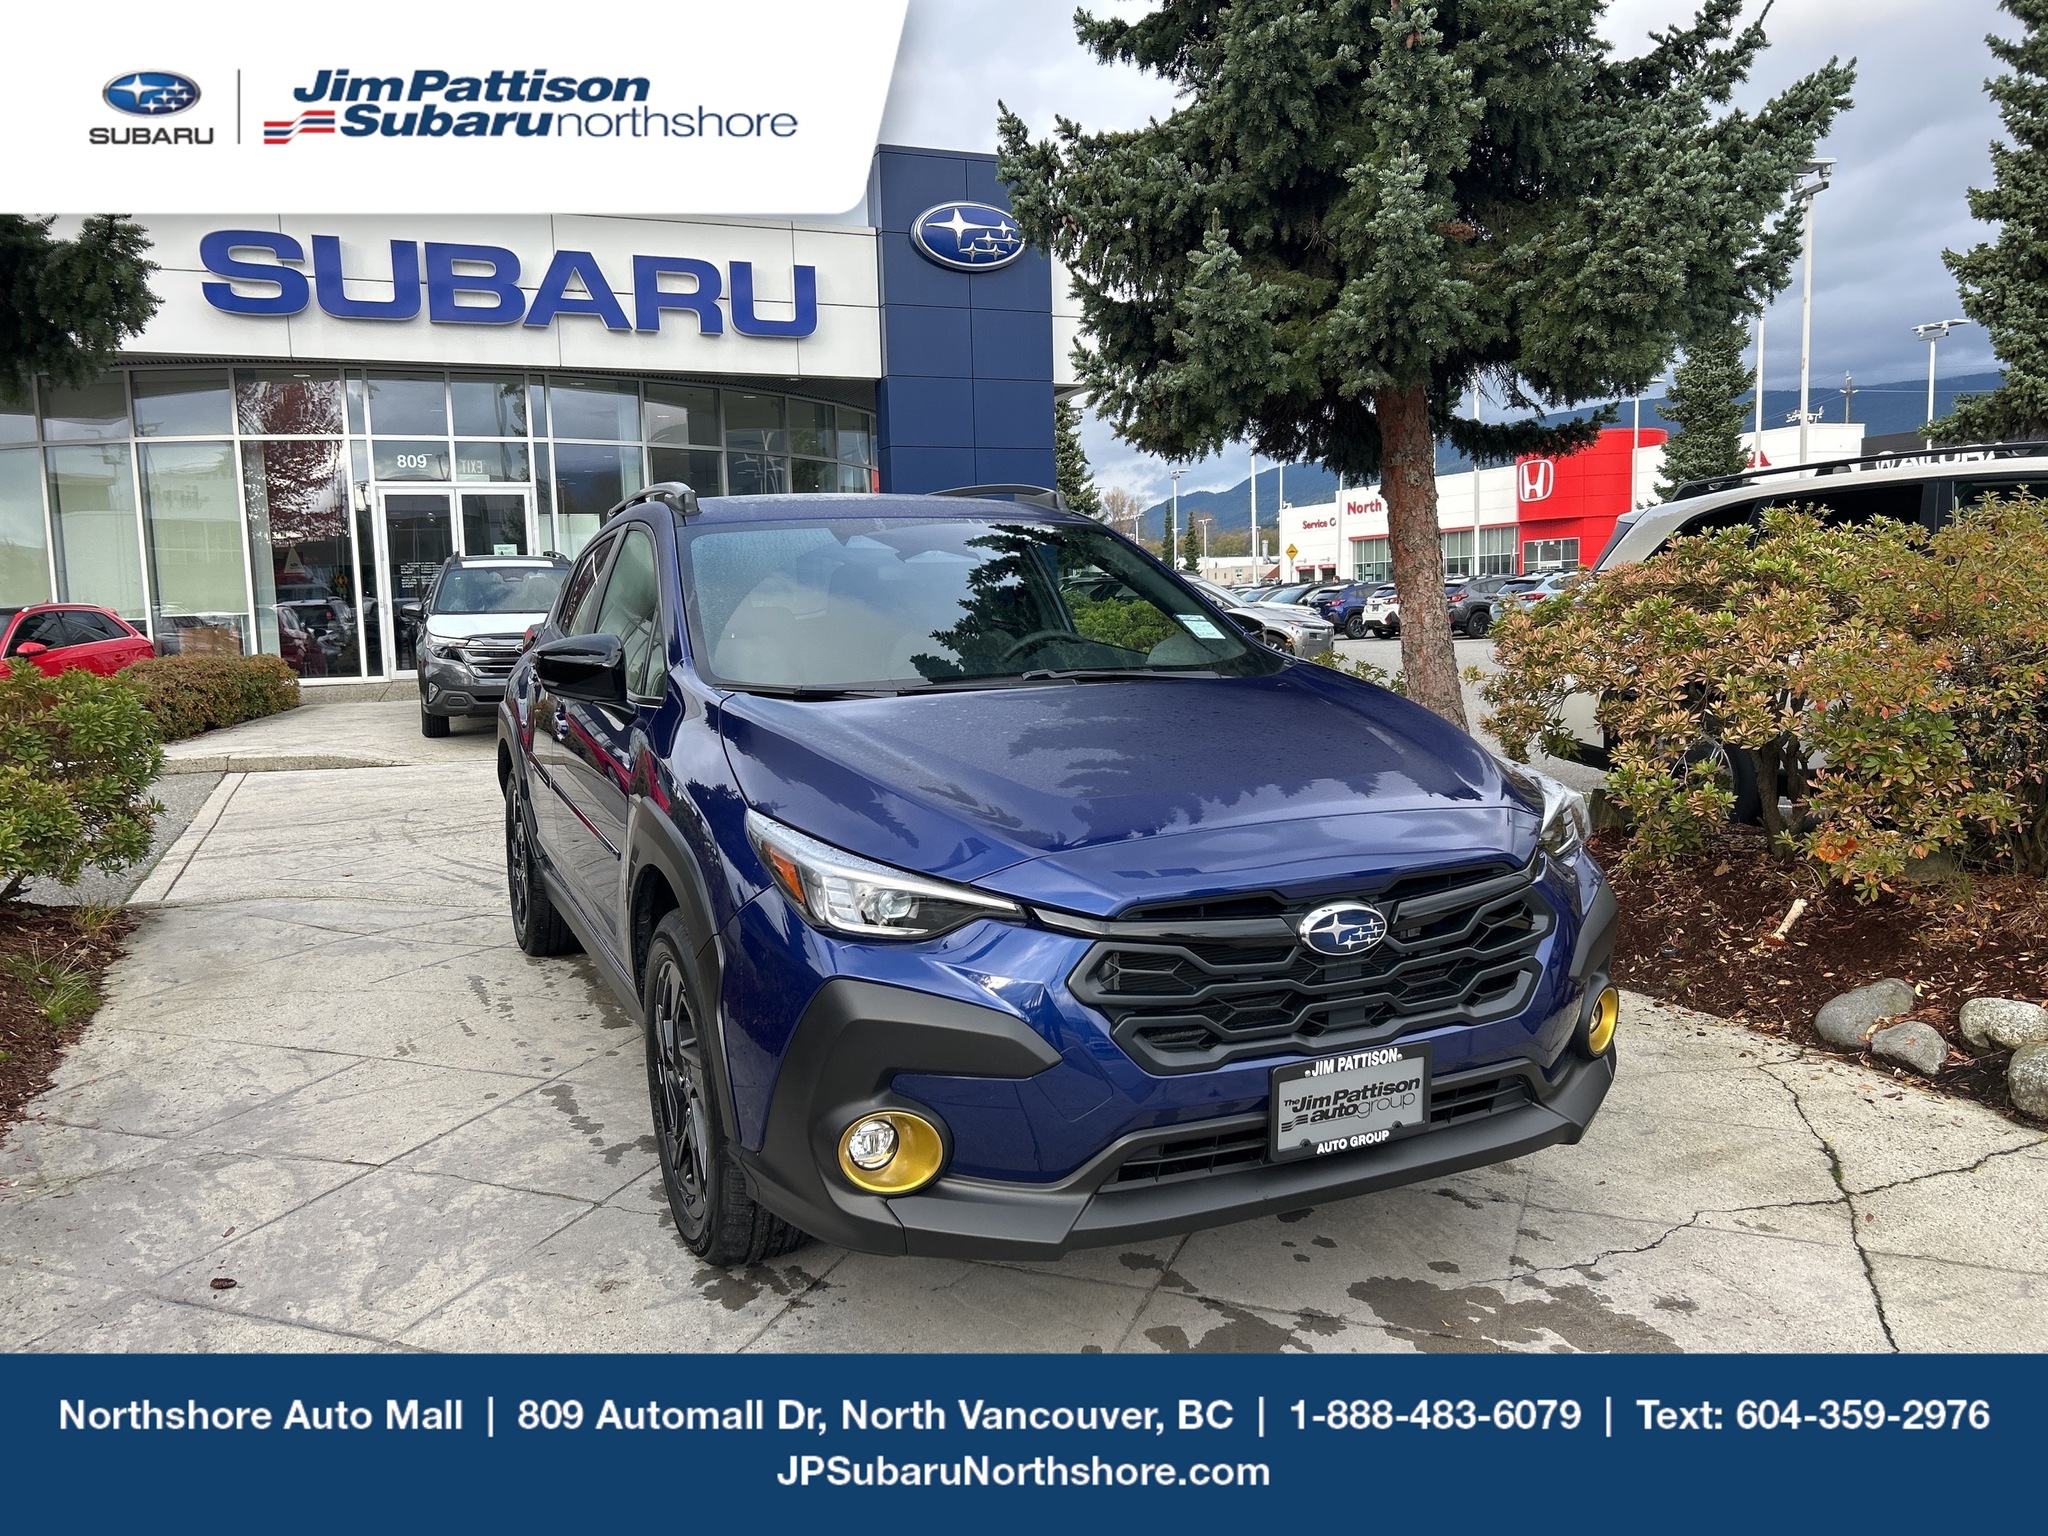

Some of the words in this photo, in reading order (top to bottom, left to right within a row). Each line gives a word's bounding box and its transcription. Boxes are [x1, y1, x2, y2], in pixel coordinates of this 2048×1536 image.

[200, 230, 818, 338] SUBARU
[396, 454, 427, 469] 809
[1347, 498, 1382, 515] North
[1302, 518, 1328, 530] Service
[1311, 1058, 1335, 1077] JIM
[1337, 1048, 1398, 1073] PATTISON
[1316, 1139, 1348, 1155] AUTO
[1350, 1130, 1390, 1148] GROUP
